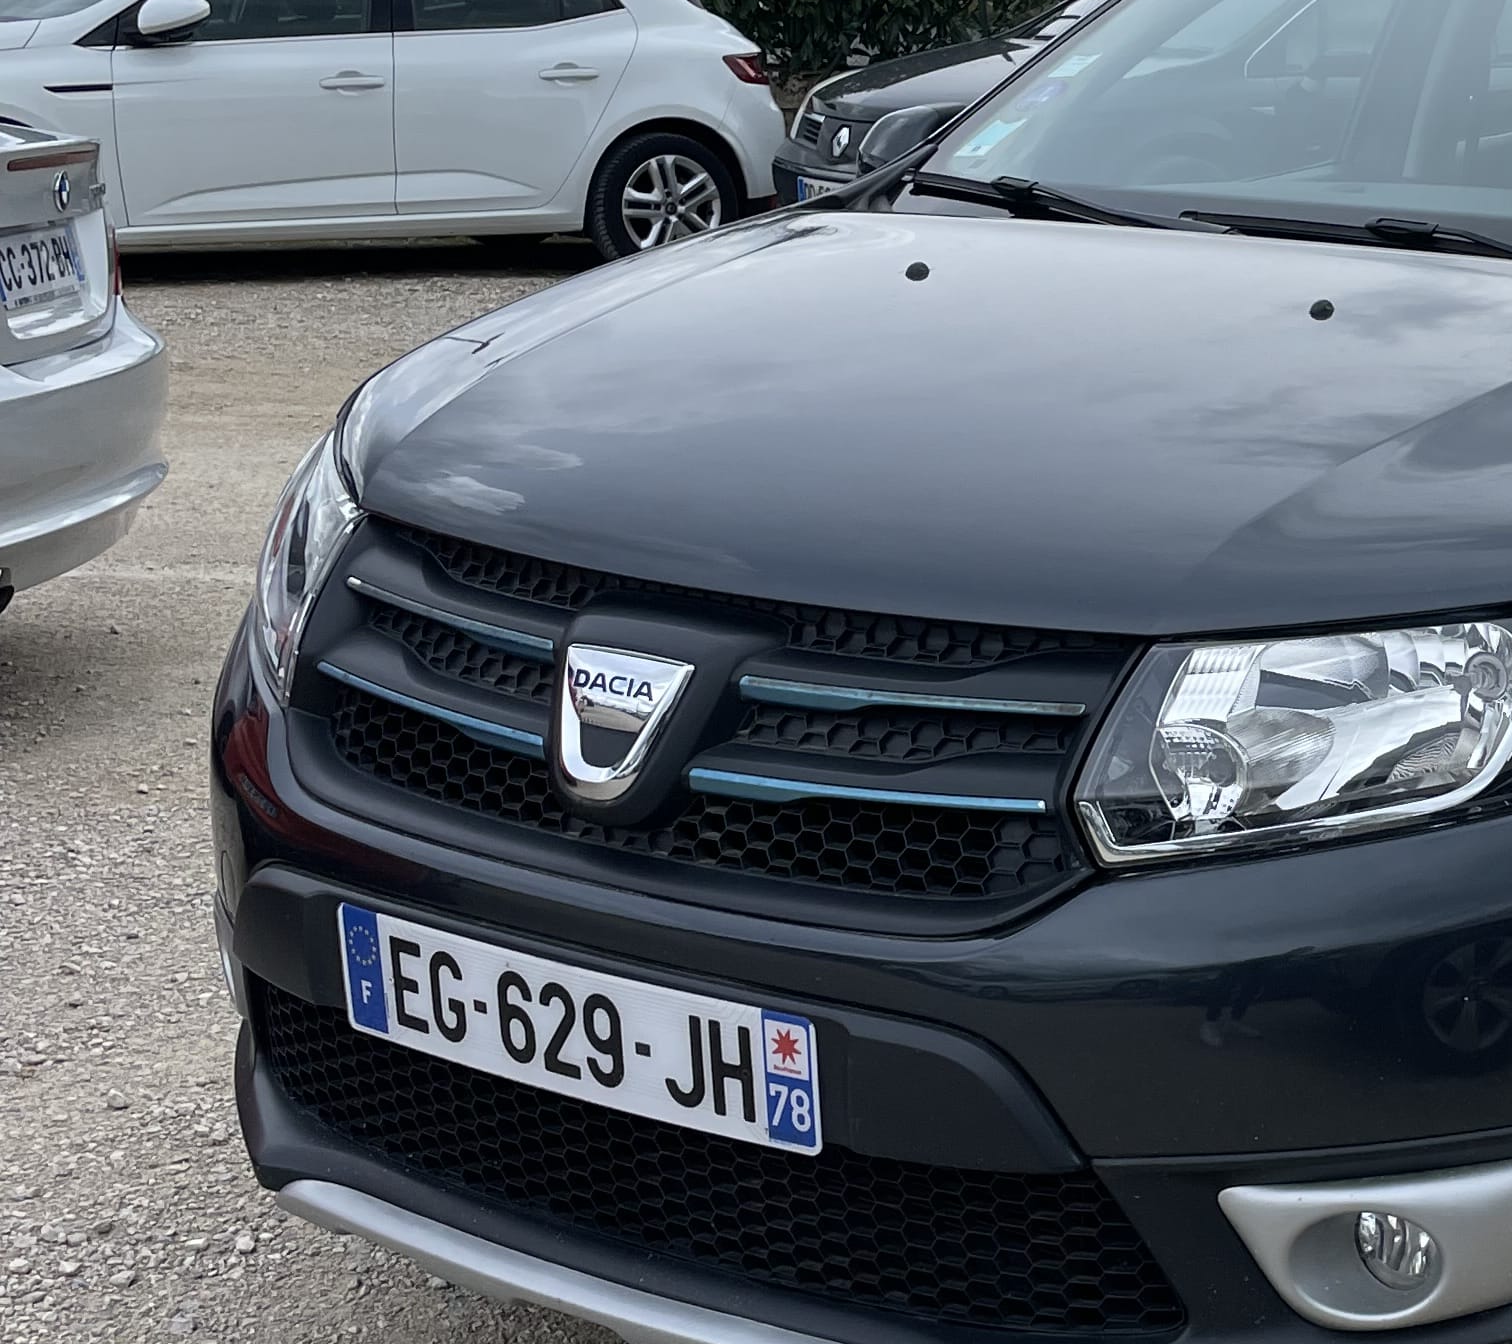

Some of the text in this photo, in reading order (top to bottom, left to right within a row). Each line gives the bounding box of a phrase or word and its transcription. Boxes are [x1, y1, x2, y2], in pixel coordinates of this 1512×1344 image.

[573, 668, 654, 702] DACIA
[361, 979, 373, 1004] F
[389, 935, 757, 1123] EG-629-JH
[768, 1082, 811, 1133] 78
